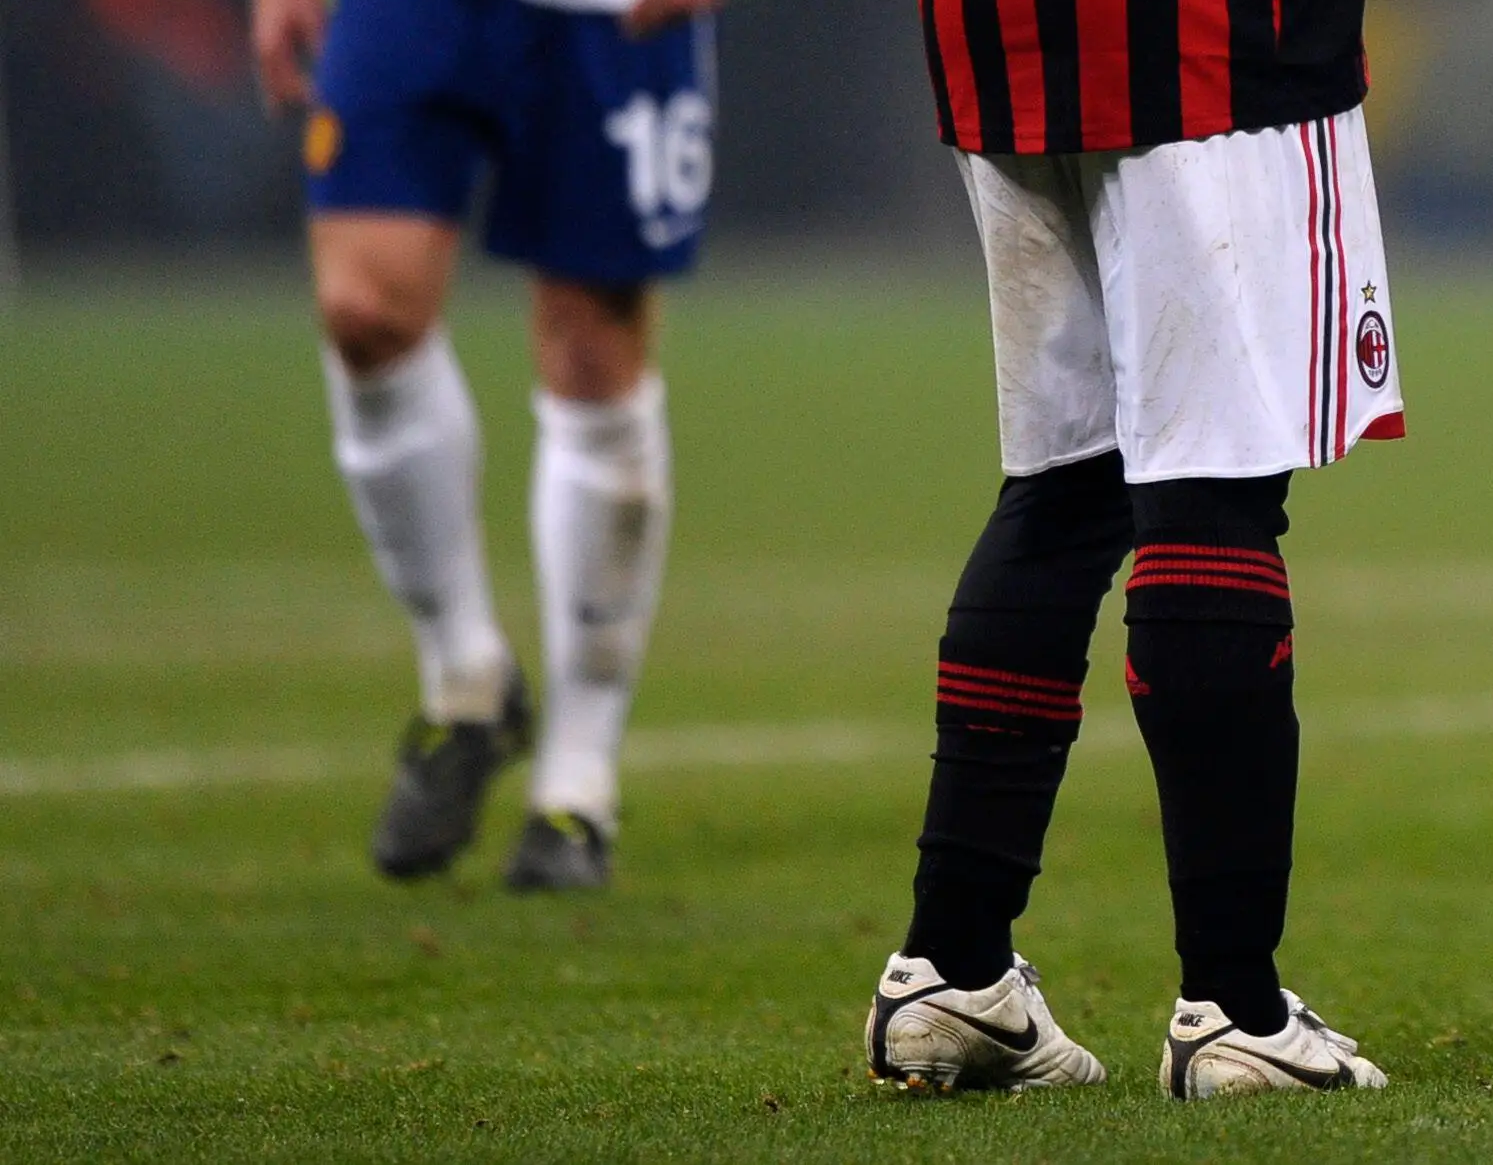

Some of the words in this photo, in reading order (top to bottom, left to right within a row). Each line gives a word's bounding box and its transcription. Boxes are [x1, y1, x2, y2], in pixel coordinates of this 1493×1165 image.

[603, 89, 714, 214] 16
[887, 969, 914, 985] NIKE
[1177, 1013, 1205, 1028] NIKE
